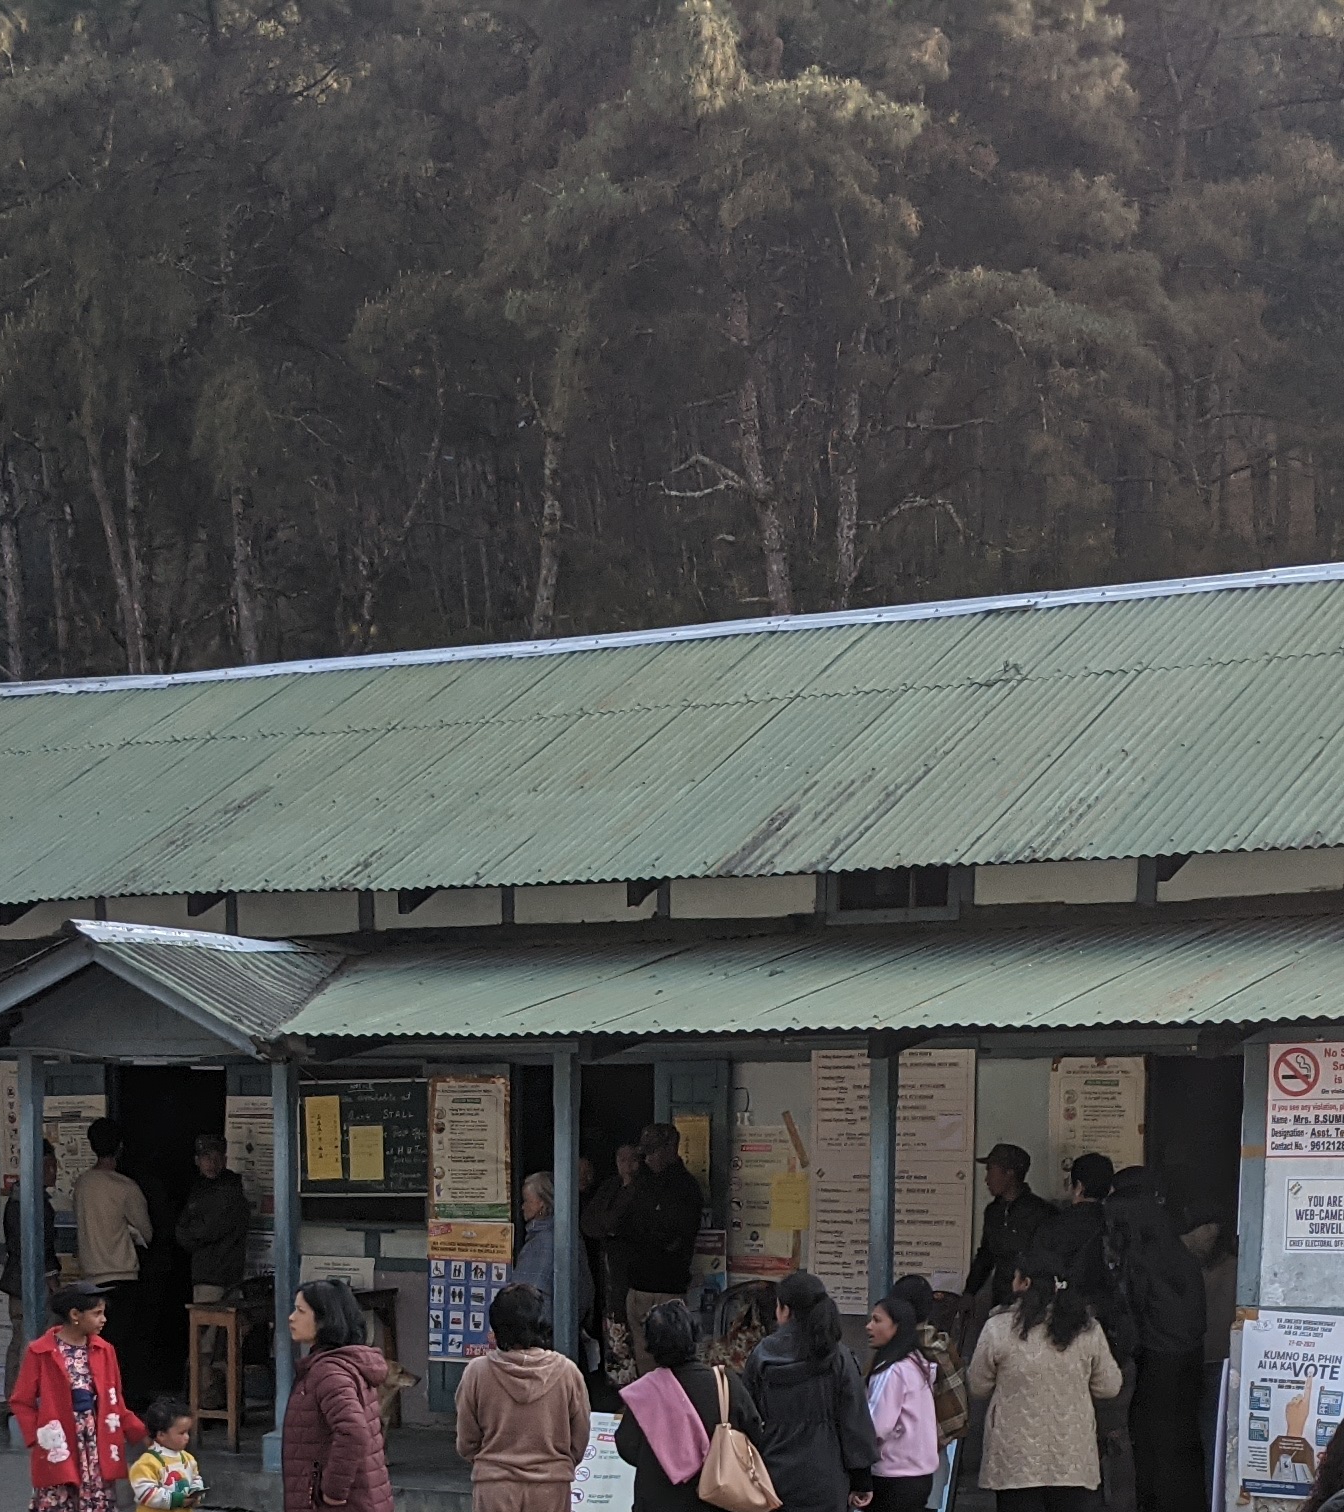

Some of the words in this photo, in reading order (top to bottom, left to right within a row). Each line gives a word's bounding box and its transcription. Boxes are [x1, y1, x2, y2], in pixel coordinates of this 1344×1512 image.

[1324, 1048, 1337, 1057] No
[1334, 1075, 1342, 1084] is
[1278, 1104, 1288, 1112] you
[1301, 1104, 1311, 1112] any
[1271, 1115, 1288, 1124] Name
[1293, 1115, 1311, 1124] Mrs.
[1271, 1128, 1304, 1139] Designation
[1310, 1128, 1332, 1137] Asst.
[1271, 1141, 1293, 1150] Contact
[1308, 1196, 1324, 1207] YOU
[1327, 1196, 1343, 1207] ARE
[1264, 1350, 1299, 1361] KUMNO
[1302, 1353, 1315, 1363] BA
[1318, 1354, 1342, 1364] PHIN
[1258, 1360, 1266, 1369] AI
[1269, 1361, 1277, 1370] IA
[1280, 1361, 1292, 1371] KA
[1292, 1362, 1340, 1380] VOTE
